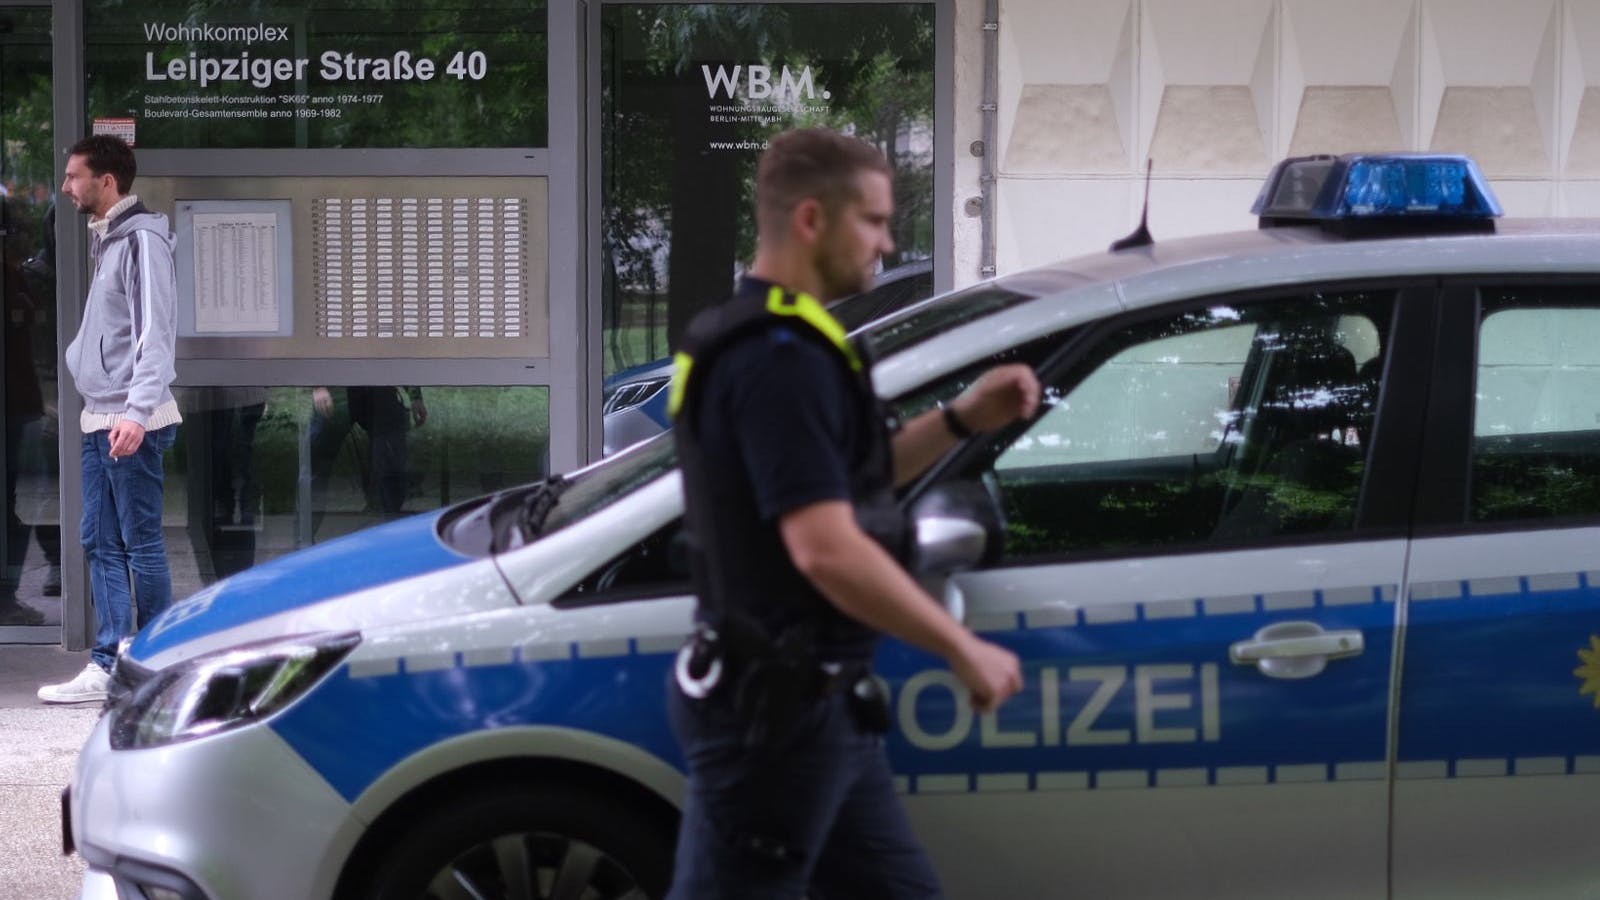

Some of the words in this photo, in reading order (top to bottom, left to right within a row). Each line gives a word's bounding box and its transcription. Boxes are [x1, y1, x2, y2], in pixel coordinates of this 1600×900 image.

[144, 23, 288, 45] Wohnkomplex
[146, 51, 308, 87] Leipziger
[319, 50, 435, 81] Straße
[446, 51, 487, 81] 40
[144, 94, 276, 104] Stahlbetonskelett-Konstruktion
[312, 96, 334, 104] anno
[337, 94, 383, 104] 1974-1977
[144, 109, 268, 118] Boulevard-Gesamtensemble
[295, 109, 341, 118] 1969-1982
[710, 139, 768, 150] www.wbm.d
[879, 663, 1221, 752] OLIZEI
